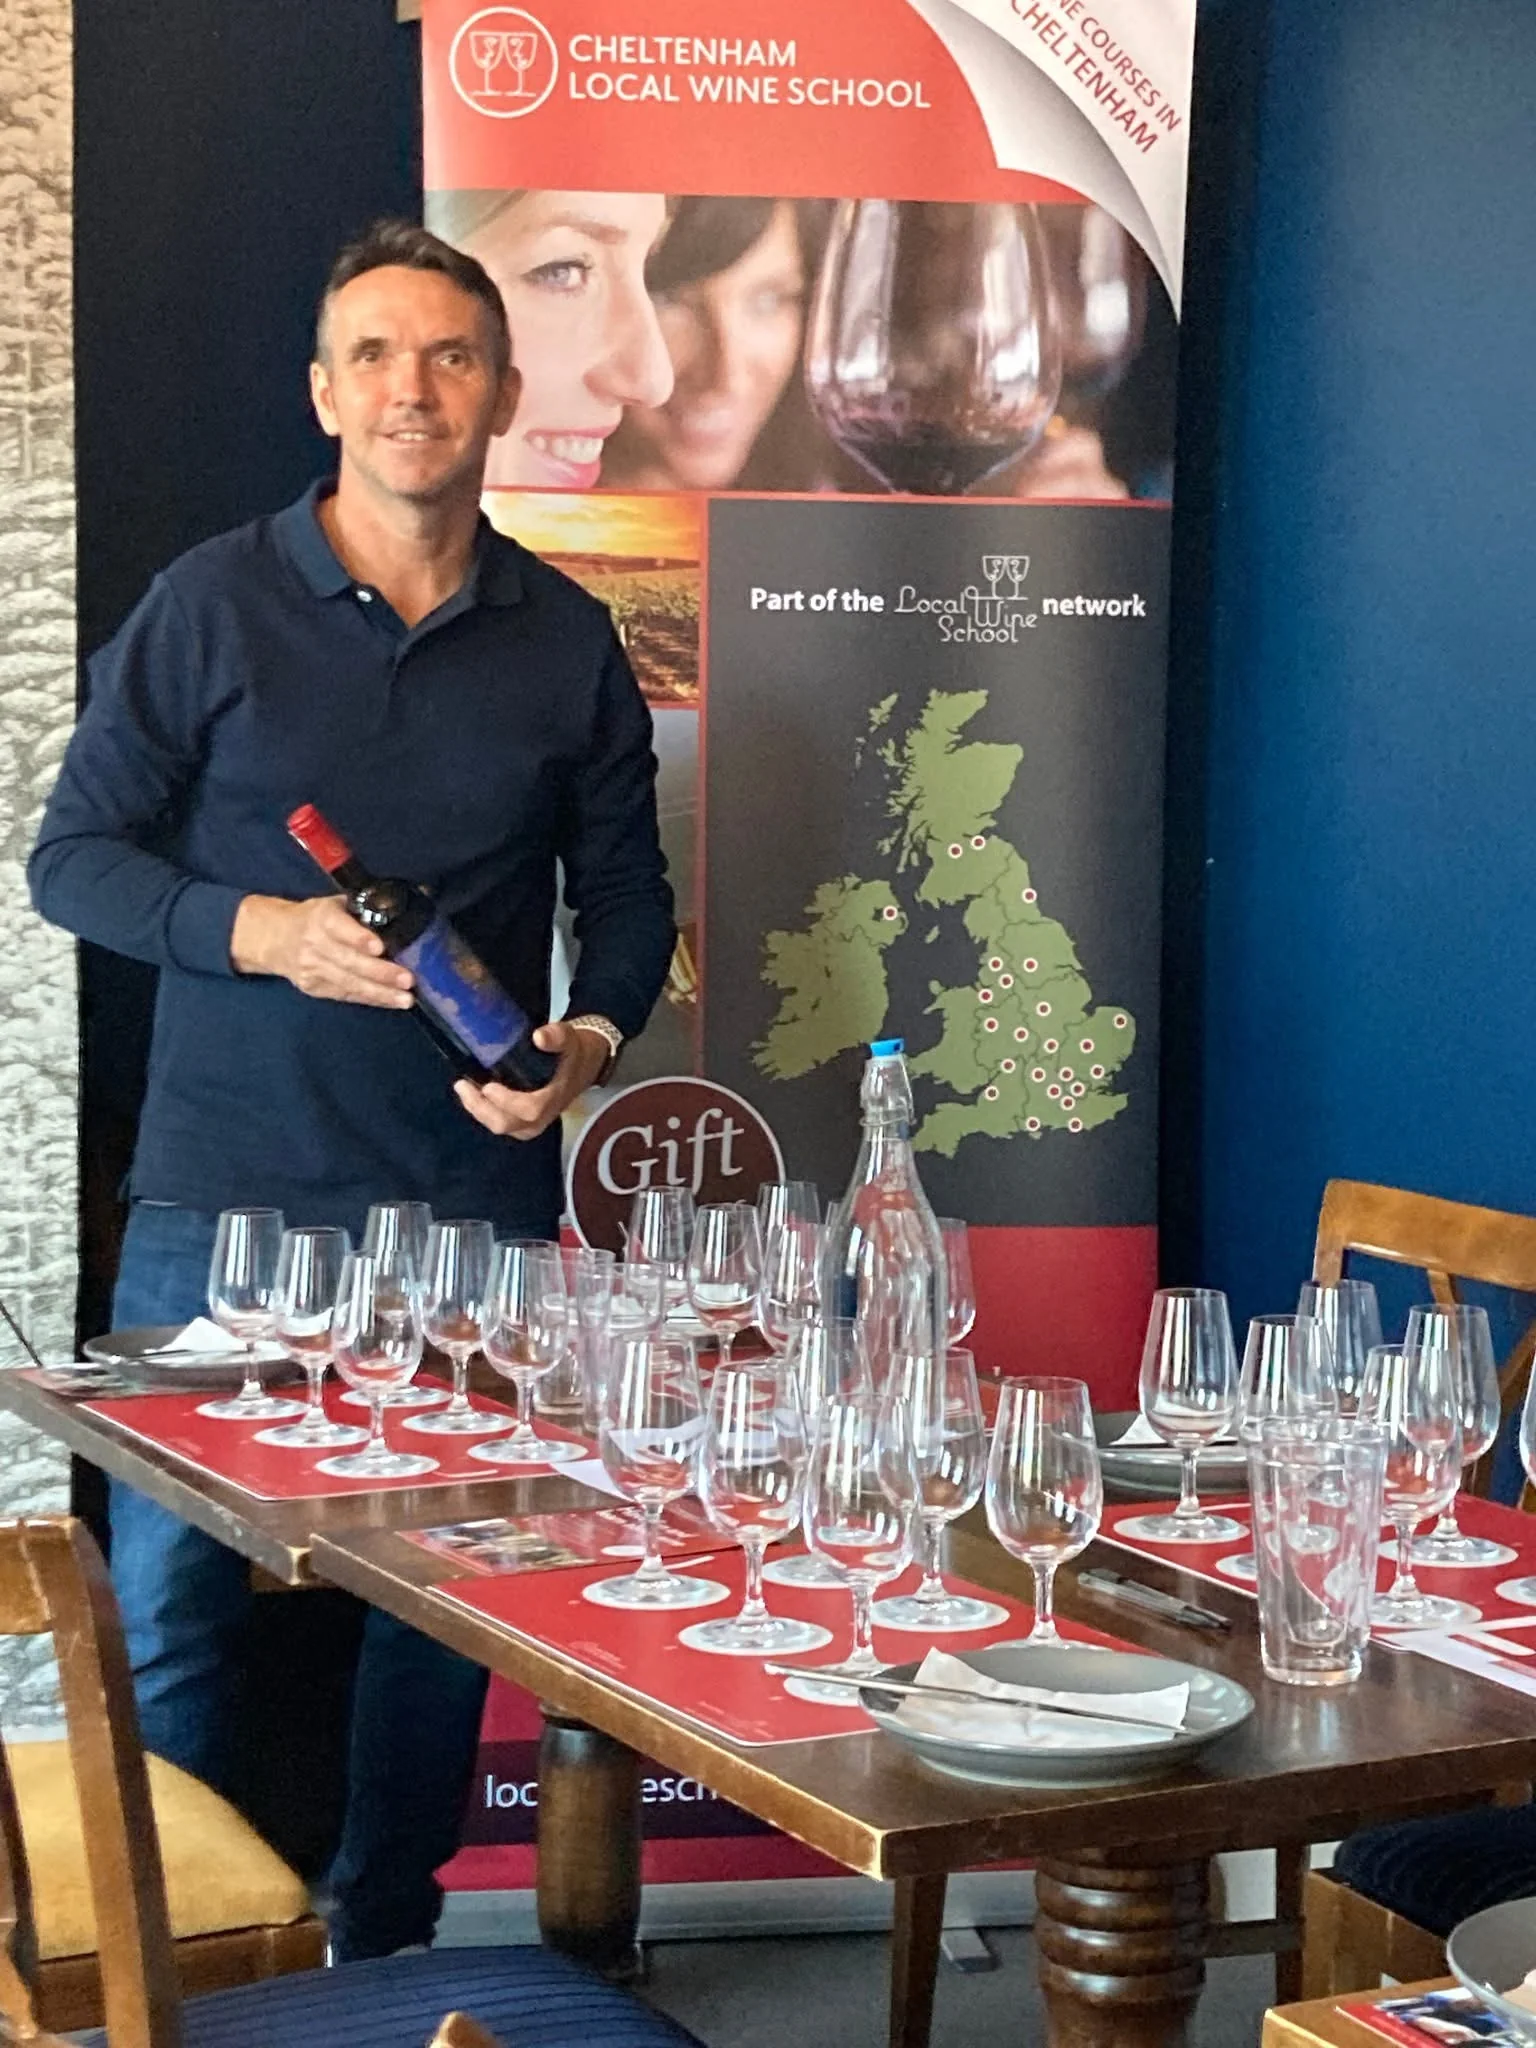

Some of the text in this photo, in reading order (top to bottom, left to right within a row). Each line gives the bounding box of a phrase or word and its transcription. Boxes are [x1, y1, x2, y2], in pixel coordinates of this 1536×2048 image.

[569, 34, 797, 67] CHELTENHAM
[569, 72, 931, 108] LOCAL WINE SCHOOL
[1080, 16, 1162, 108] COURSES
[1154, 103, 1182, 132] IN
[750, 585, 1147, 628] Part of the Local Wine network
[938, 615, 1019, 643] School
[597, 1107, 745, 1195] Gift
